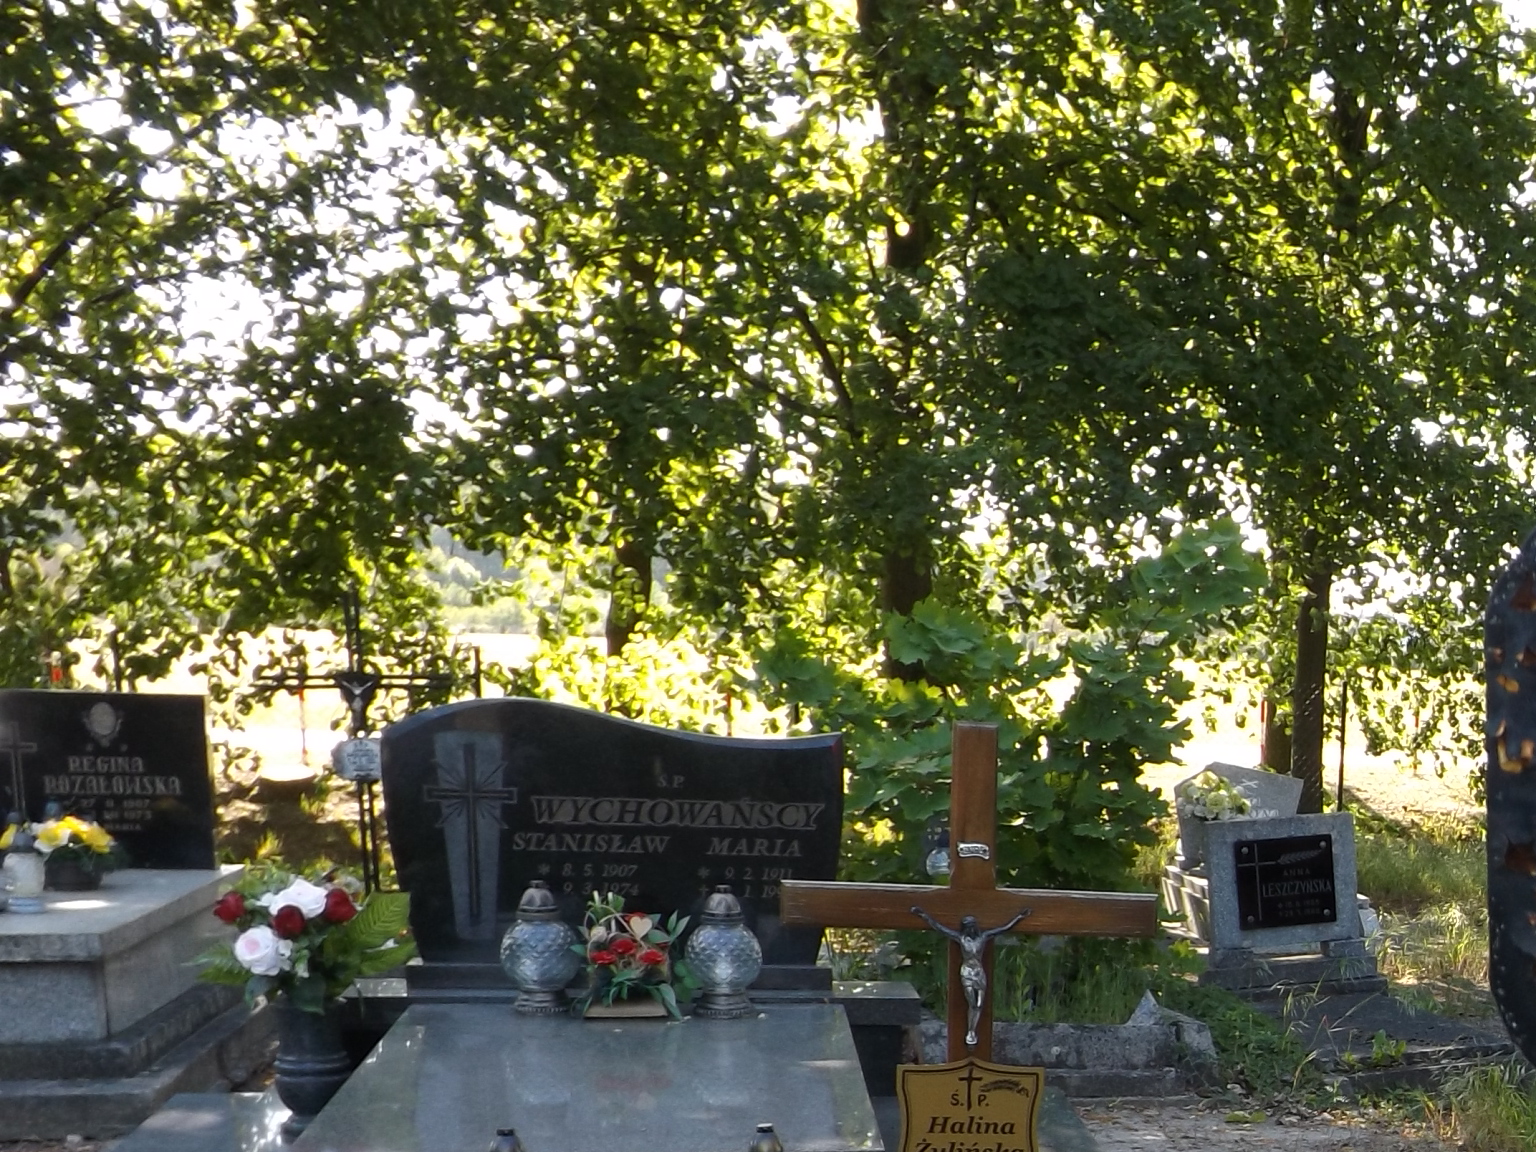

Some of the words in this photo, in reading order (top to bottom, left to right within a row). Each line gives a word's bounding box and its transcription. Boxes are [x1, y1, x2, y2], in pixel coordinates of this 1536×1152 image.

[513, 832, 670, 854] STANISŁAW
[706, 837, 803, 857] MARIA
[602, 863, 639, 877] 1907
[601, 882, 640, 896] 1974
[977, 1094, 990, 1107] P.
[926, 1116, 1016, 1135] Halina
